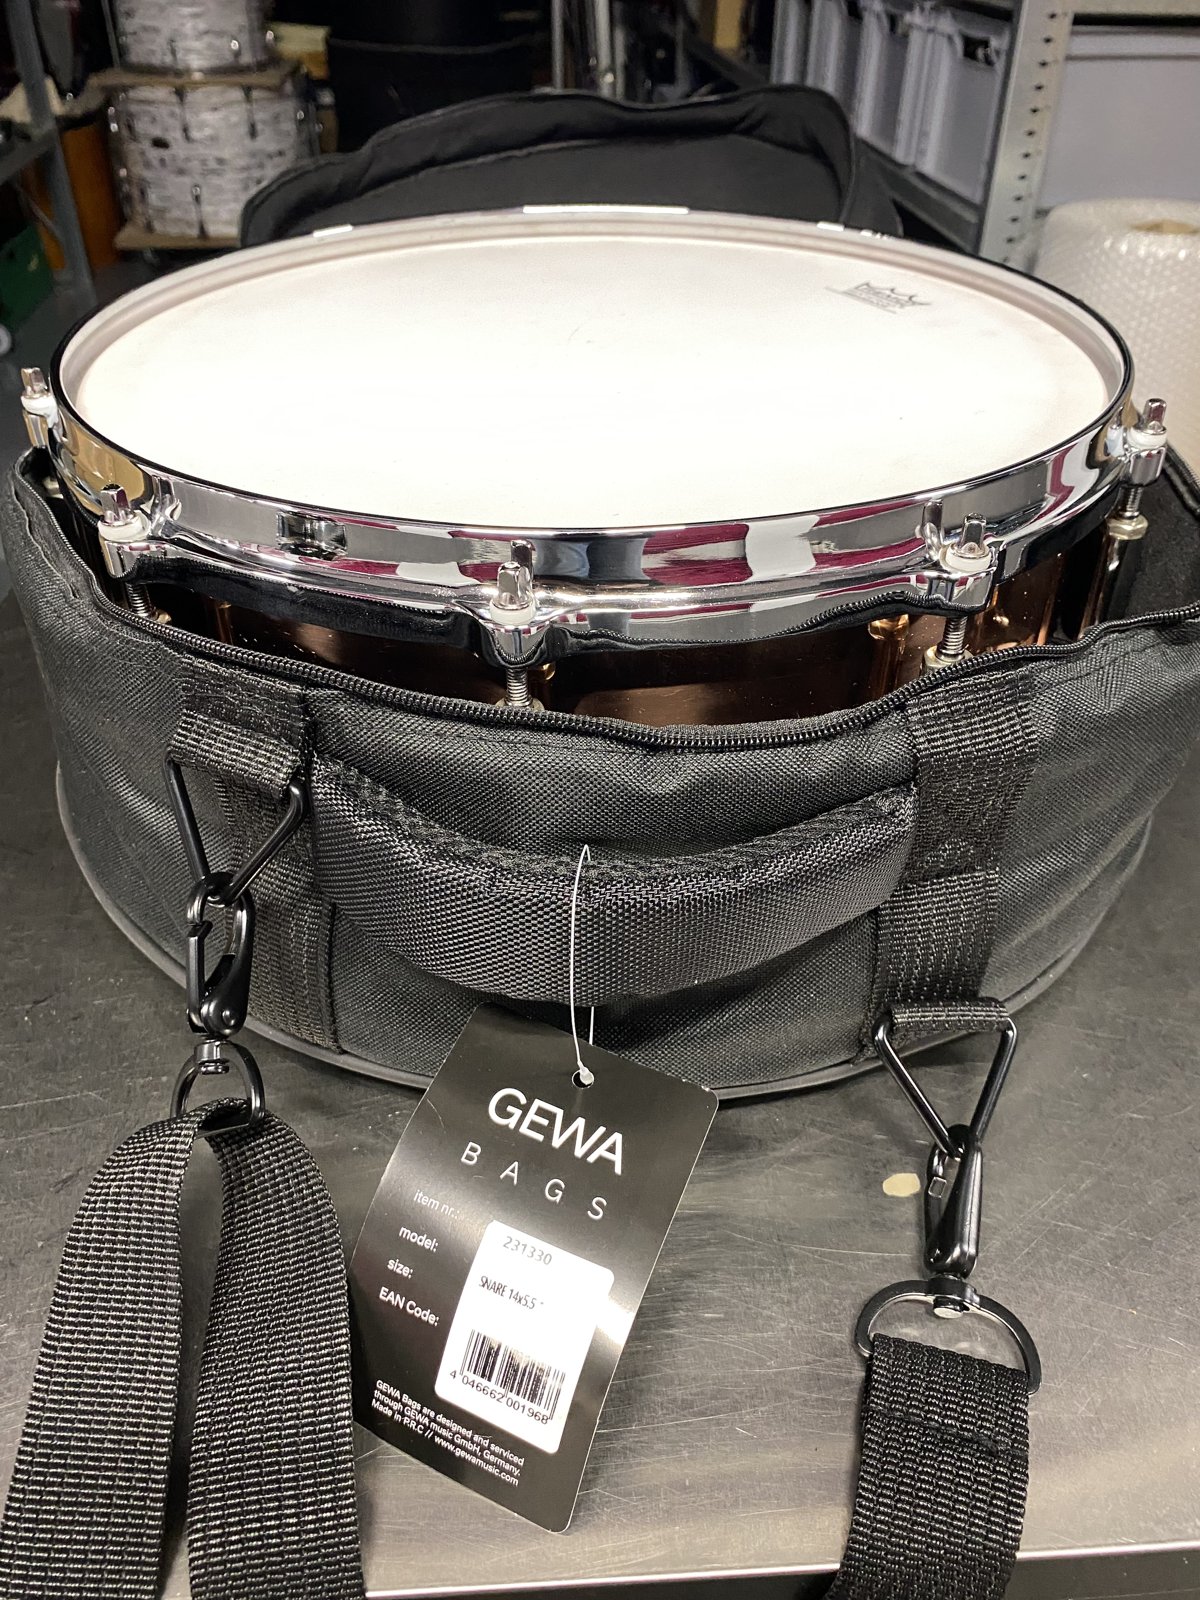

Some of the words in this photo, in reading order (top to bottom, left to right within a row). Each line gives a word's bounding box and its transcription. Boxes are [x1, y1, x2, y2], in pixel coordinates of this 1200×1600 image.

[488, 1088, 623, 1176] GEWA
[413, 1189, 440, 1210] item
[399, 1226, 439, 1253] model:
[503, 1235, 552, 1266] 231330
[387, 1258, 414, 1279] size:
[479, 1275, 508, 1297] SNARE
[379, 1286, 406, 1310] EAN
[406, 1300, 440, 1326] Code:
[374, 1389, 403, 1413] through
[404, 1406, 430, 1427] GEWA
[429, 1421, 454, 1439] music
[454, 1433, 482, 1456] GmbH,
[482, 1449, 521, 1476] Germany.
[376, 1379, 401, 1400] GEWA
[402, 1393, 422, 1411] Bags
[422, 1406, 436, 1418] are
[436, 1413, 473, 1439] designed
[473, 1433, 490, 1448] and
[490, 1443, 525, 1467] serviced
[371, 1398, 393, 1417] Made
[394, 1411, 402, 1423] in
[434, 1435, 519, 1487] www.gewamusic.com
